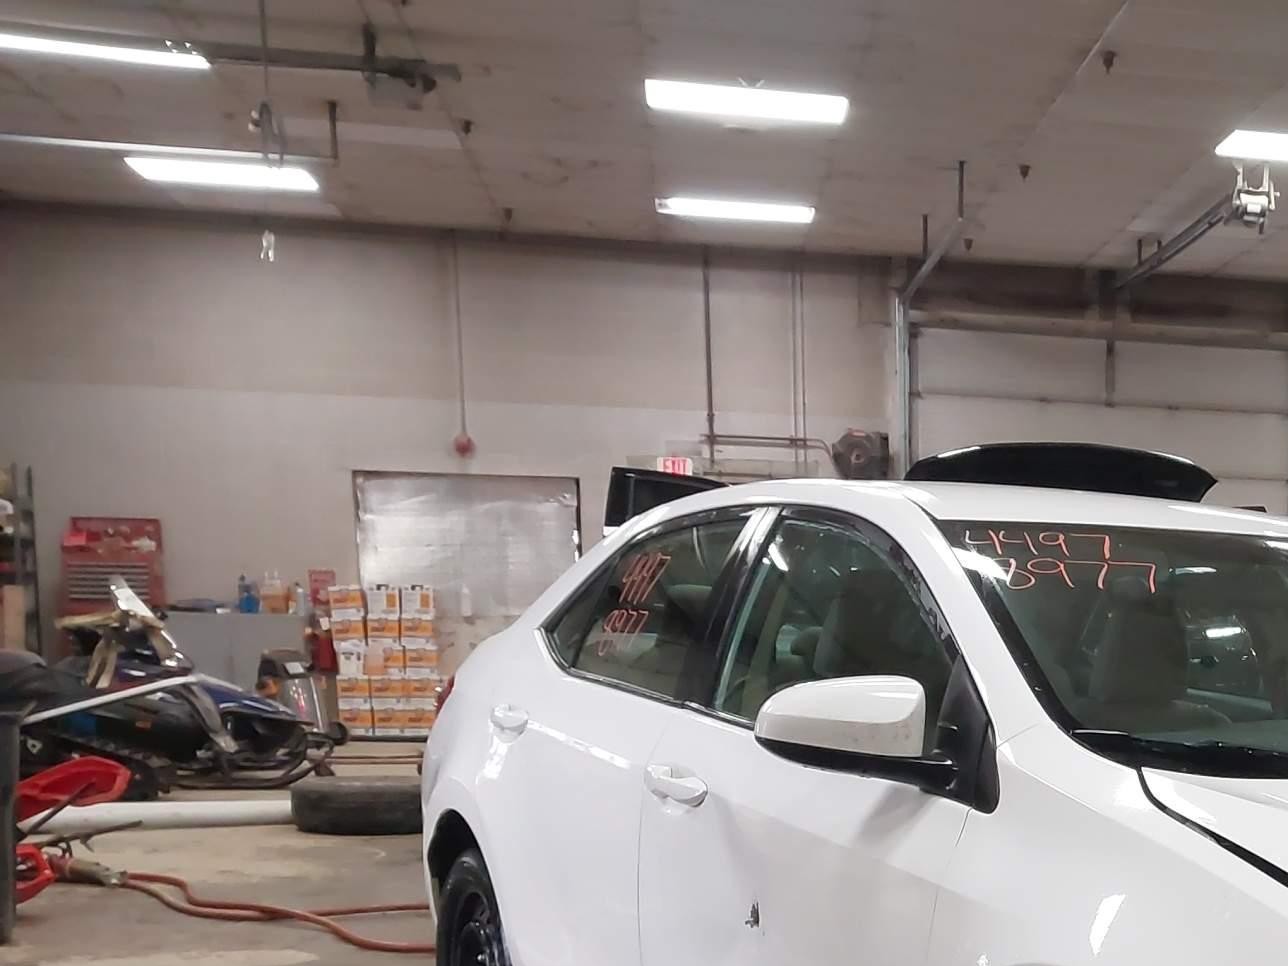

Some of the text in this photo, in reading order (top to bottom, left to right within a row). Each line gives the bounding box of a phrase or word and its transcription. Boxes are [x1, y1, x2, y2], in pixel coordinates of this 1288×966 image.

[964, 529, 1111, 560] 4497
[993, 557, 1156, 594] 8977
[597, 608, 650, 656] 8977
